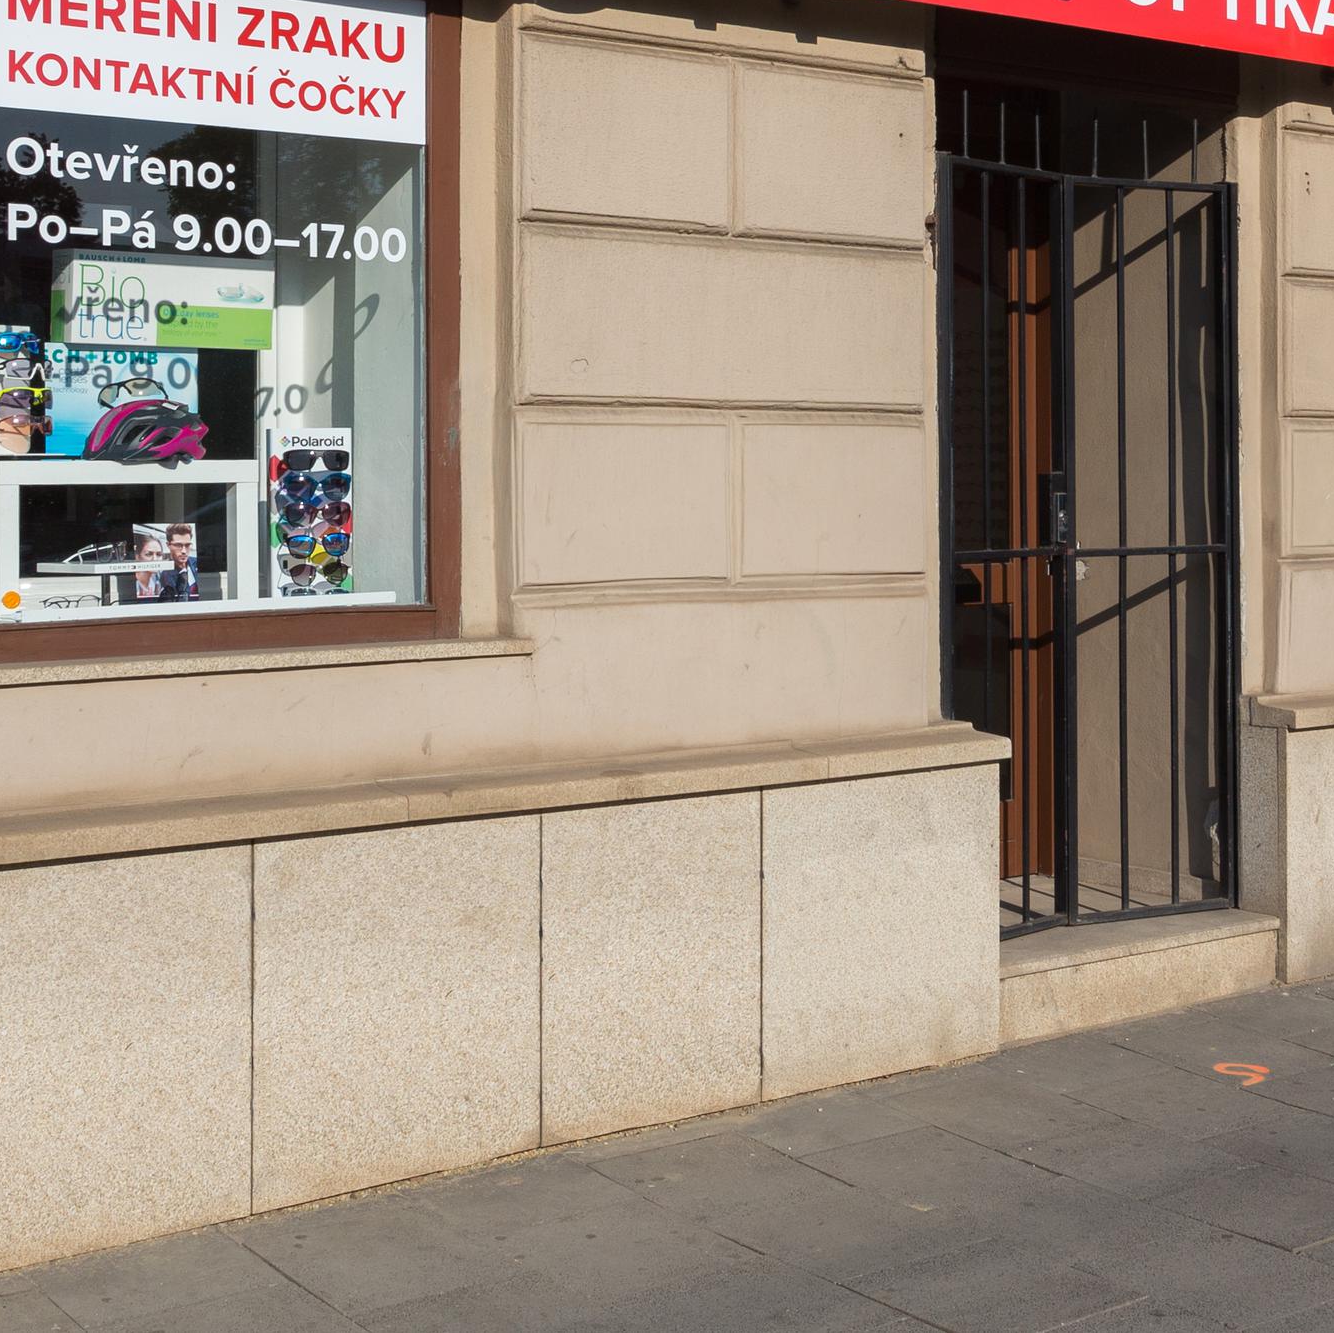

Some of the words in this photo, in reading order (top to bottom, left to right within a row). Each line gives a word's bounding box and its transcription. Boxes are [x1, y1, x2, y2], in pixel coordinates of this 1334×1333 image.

[237, 6, 406, 64] ZRAKU
[7, 49, 259, 105] KONTAKTNÍ
[269, 69, 407, 120] ČOČKY
[5, 136, 236, 191] Otevřeno:
[78, 253, 115, 262] BAUSCH
[123, 256, 147, 264] LOMB
[79, 263, 145, 309] Bio
[102, 349, 159, 365] LOMB
[291, 435, 344, 447] Polaroid
